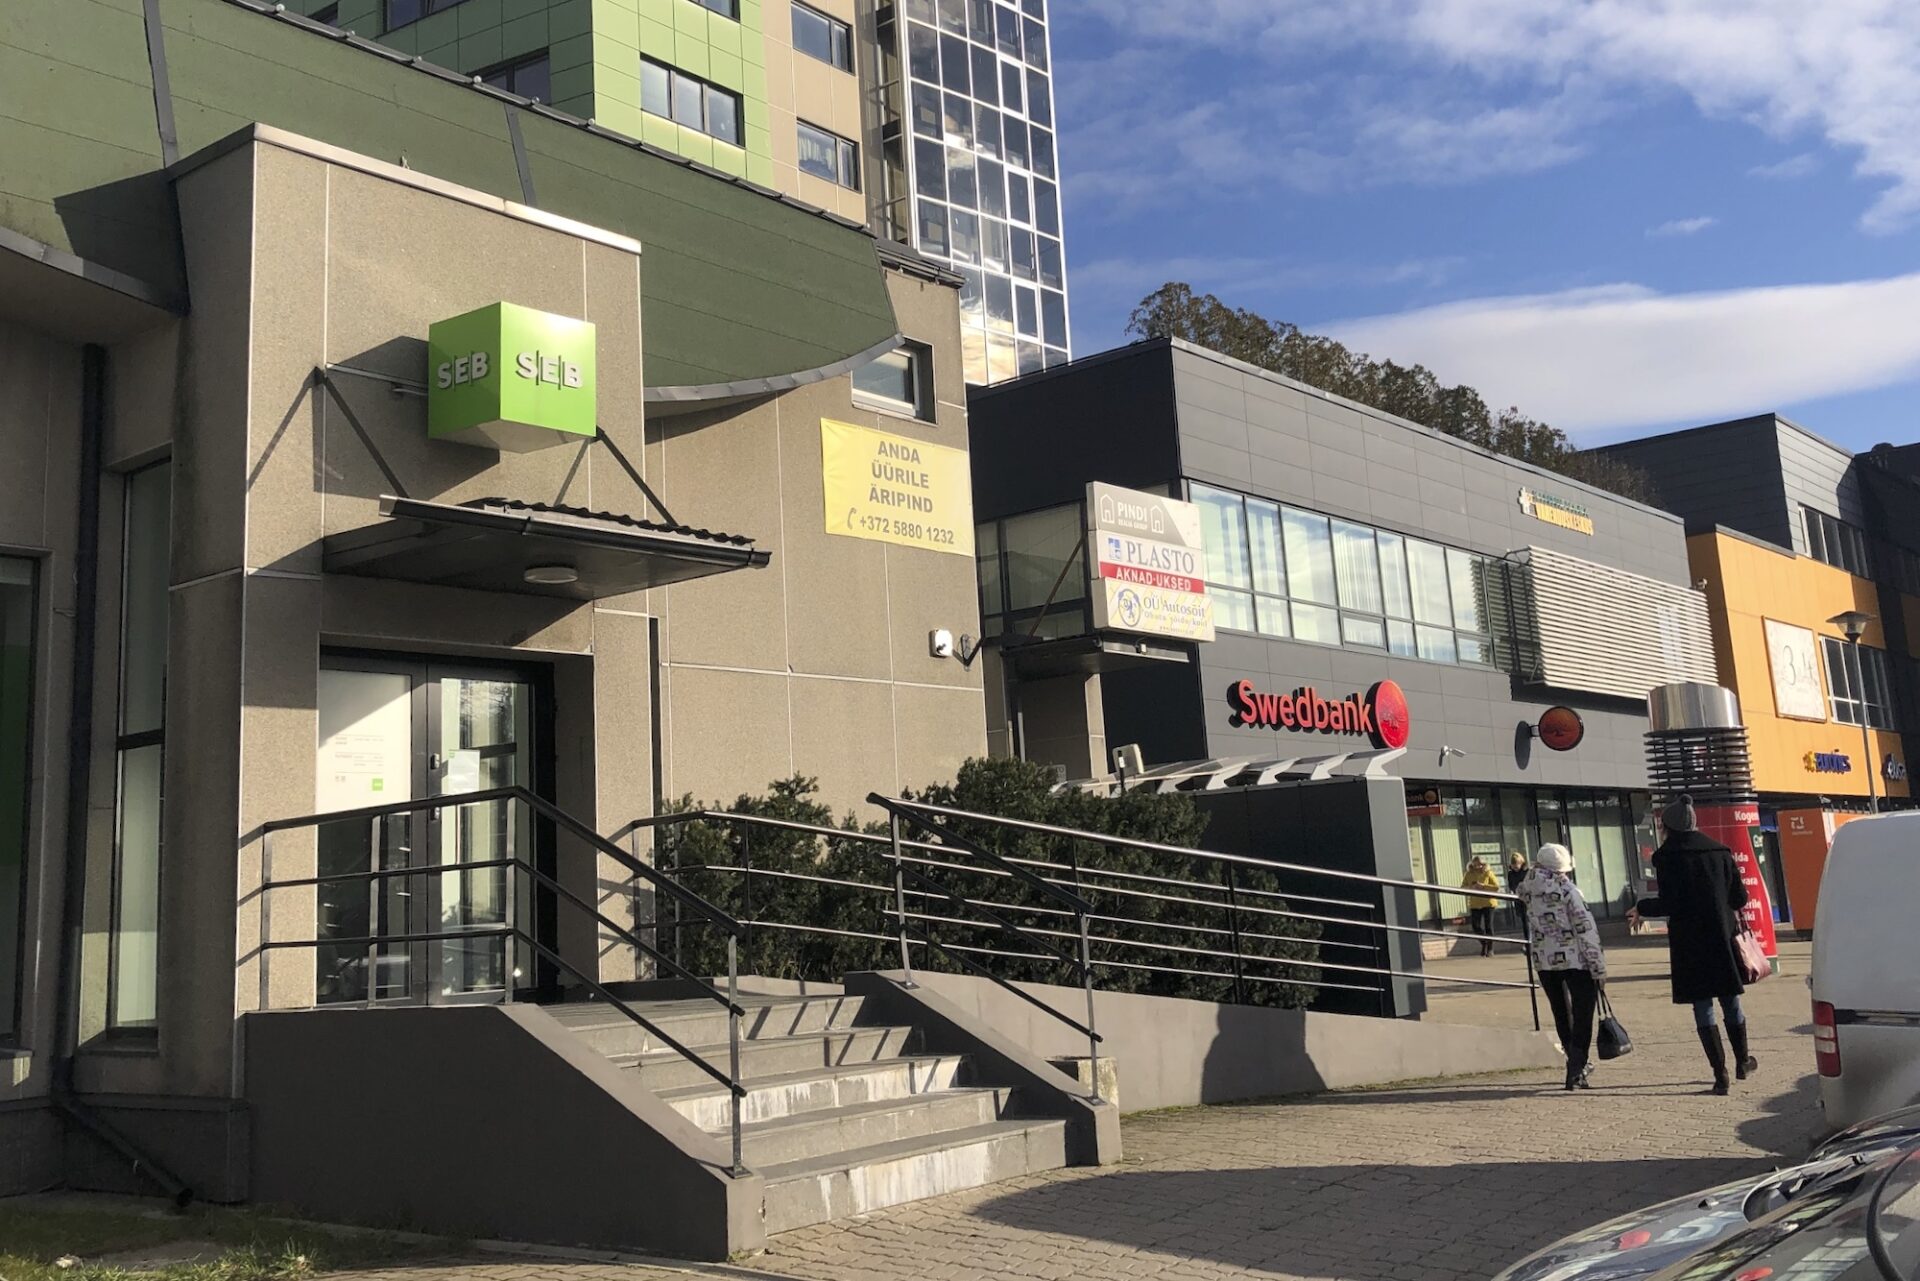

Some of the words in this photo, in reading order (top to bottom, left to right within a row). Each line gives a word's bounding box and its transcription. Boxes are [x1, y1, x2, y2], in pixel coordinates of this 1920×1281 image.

[437, 351, 488, 389] SEB
[515, 350, 583, 390] SEB
[878, 440, 921, 465] ANDA
[872, 459, 929, 489] ÜÜRILE
[869, 484, 933, 513] ÄRIPIND
[1118, 501, 1148, 523] PINDI
[860, 515, 890, 533] +372
[893, 520, 923, 539] 5880
[926, 526, 954, 545] 1232
[1125, 540, 1195, 575] PLASTO
[1116, 566, 1192, 592] AKNAD-UKSED
[1143, 594, 1160, 611] OÜ
[1237, 679, 1374, 733] Swedbank
